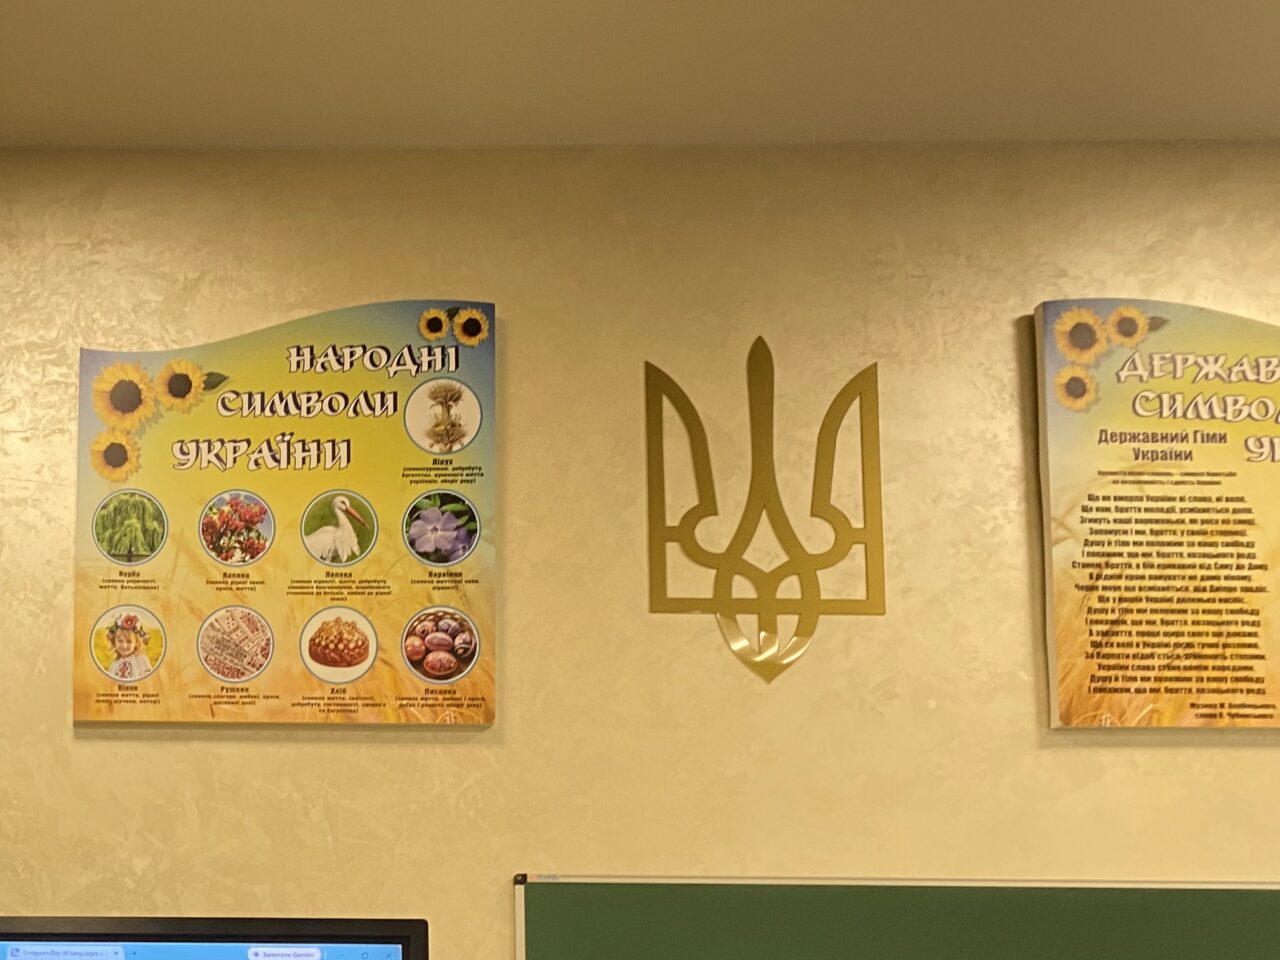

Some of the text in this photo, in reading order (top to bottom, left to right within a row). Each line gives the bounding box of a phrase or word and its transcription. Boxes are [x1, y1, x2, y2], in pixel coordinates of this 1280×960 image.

[287, 344, 460, 378] НАРОДНІ
[217, 389, 399, 419] СИМВОЛИ
[1132, 390, 1280, 424] СИМВО
[171, 432, 351, 471] УКРАЇНИ
[1097, 429, 1190, 445] Державний
[1132, 447, 1193, 462] України
